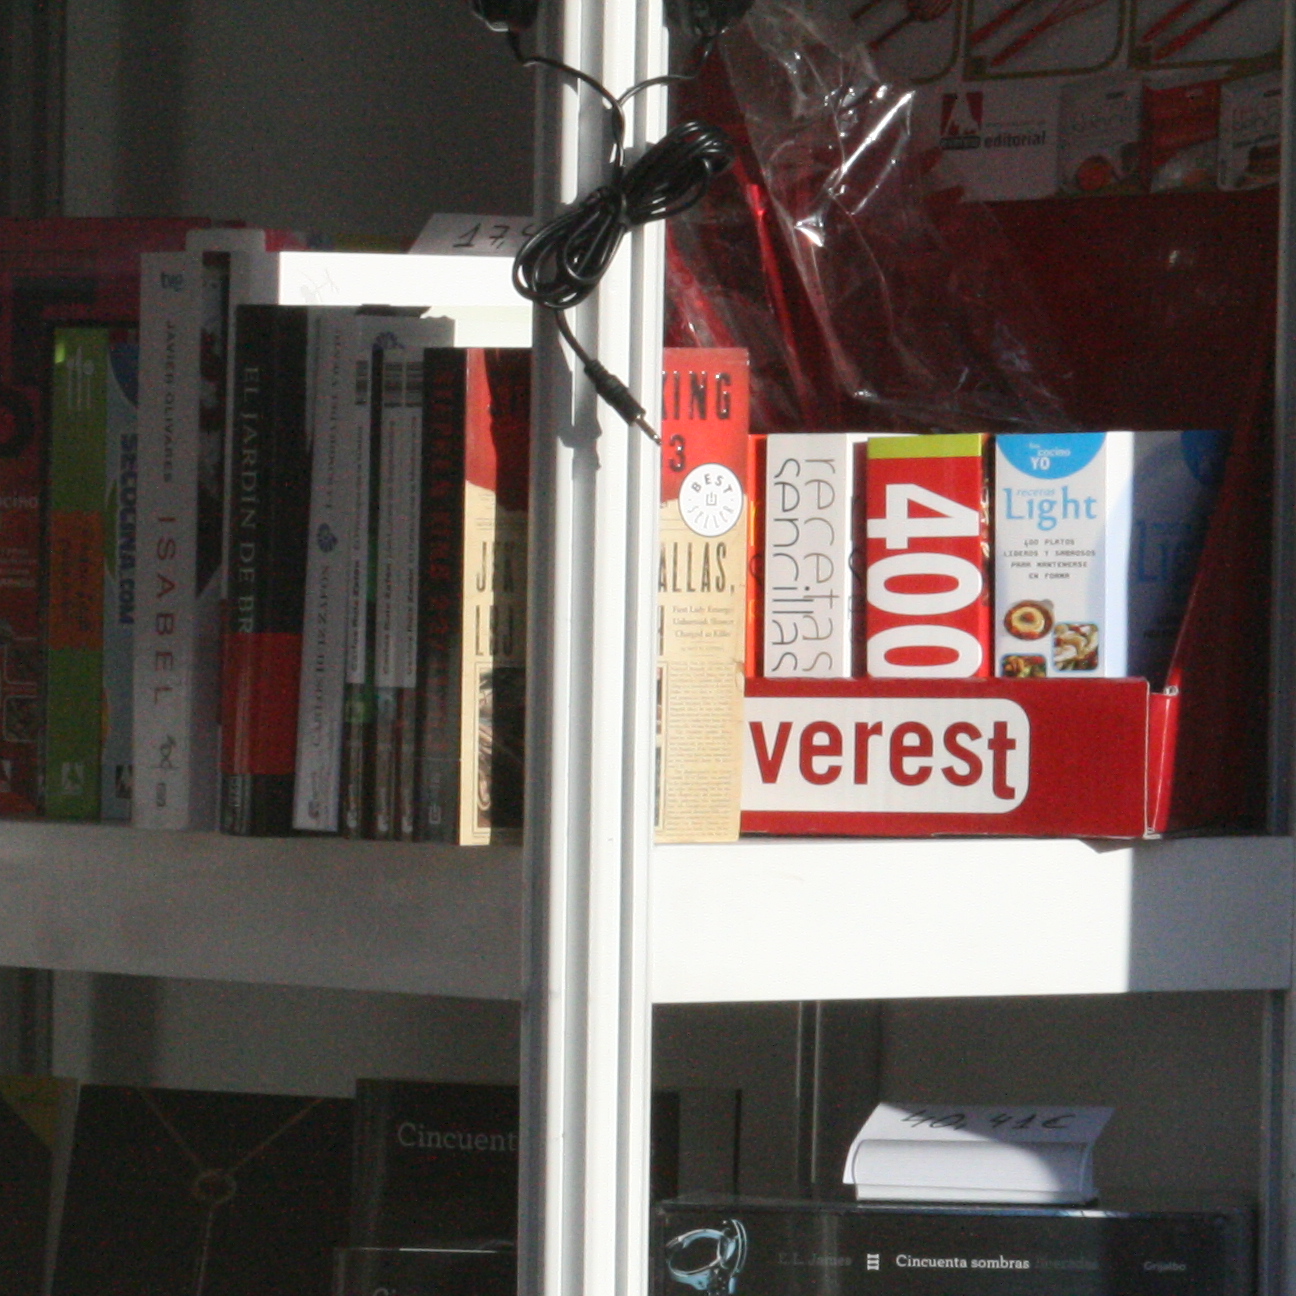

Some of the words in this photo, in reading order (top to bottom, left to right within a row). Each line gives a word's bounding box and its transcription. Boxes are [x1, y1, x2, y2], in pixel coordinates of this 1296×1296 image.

[984, 132, 1046, 148] editorial
[163, 320, 175, 385] JAVIER
[163, 390, 175, 484] OLIVARES
[1030, 457, 1051, 470] YO
[239, 410, 262, 530] JARDÍN
[691, 472, 734, 495] BEST
[688, 503, 736, 530] SELLER
[1003, 486, 1098, 531] Light
[239, 543, 259, 583] DE
[771, 457, 814, 672] sencillas
[802, 458, 840, 672] recetas
[866, 483, 984, 679] 400
[153, 515, 176, 706] ISABEL
[748, 719, 1018, 800] verest
[895, 1254, 968, 1269] Cincuenta
[971, 1254, 1031, 1270] sombras
[1142, 1260, 1187, 1273] Grijalbo
